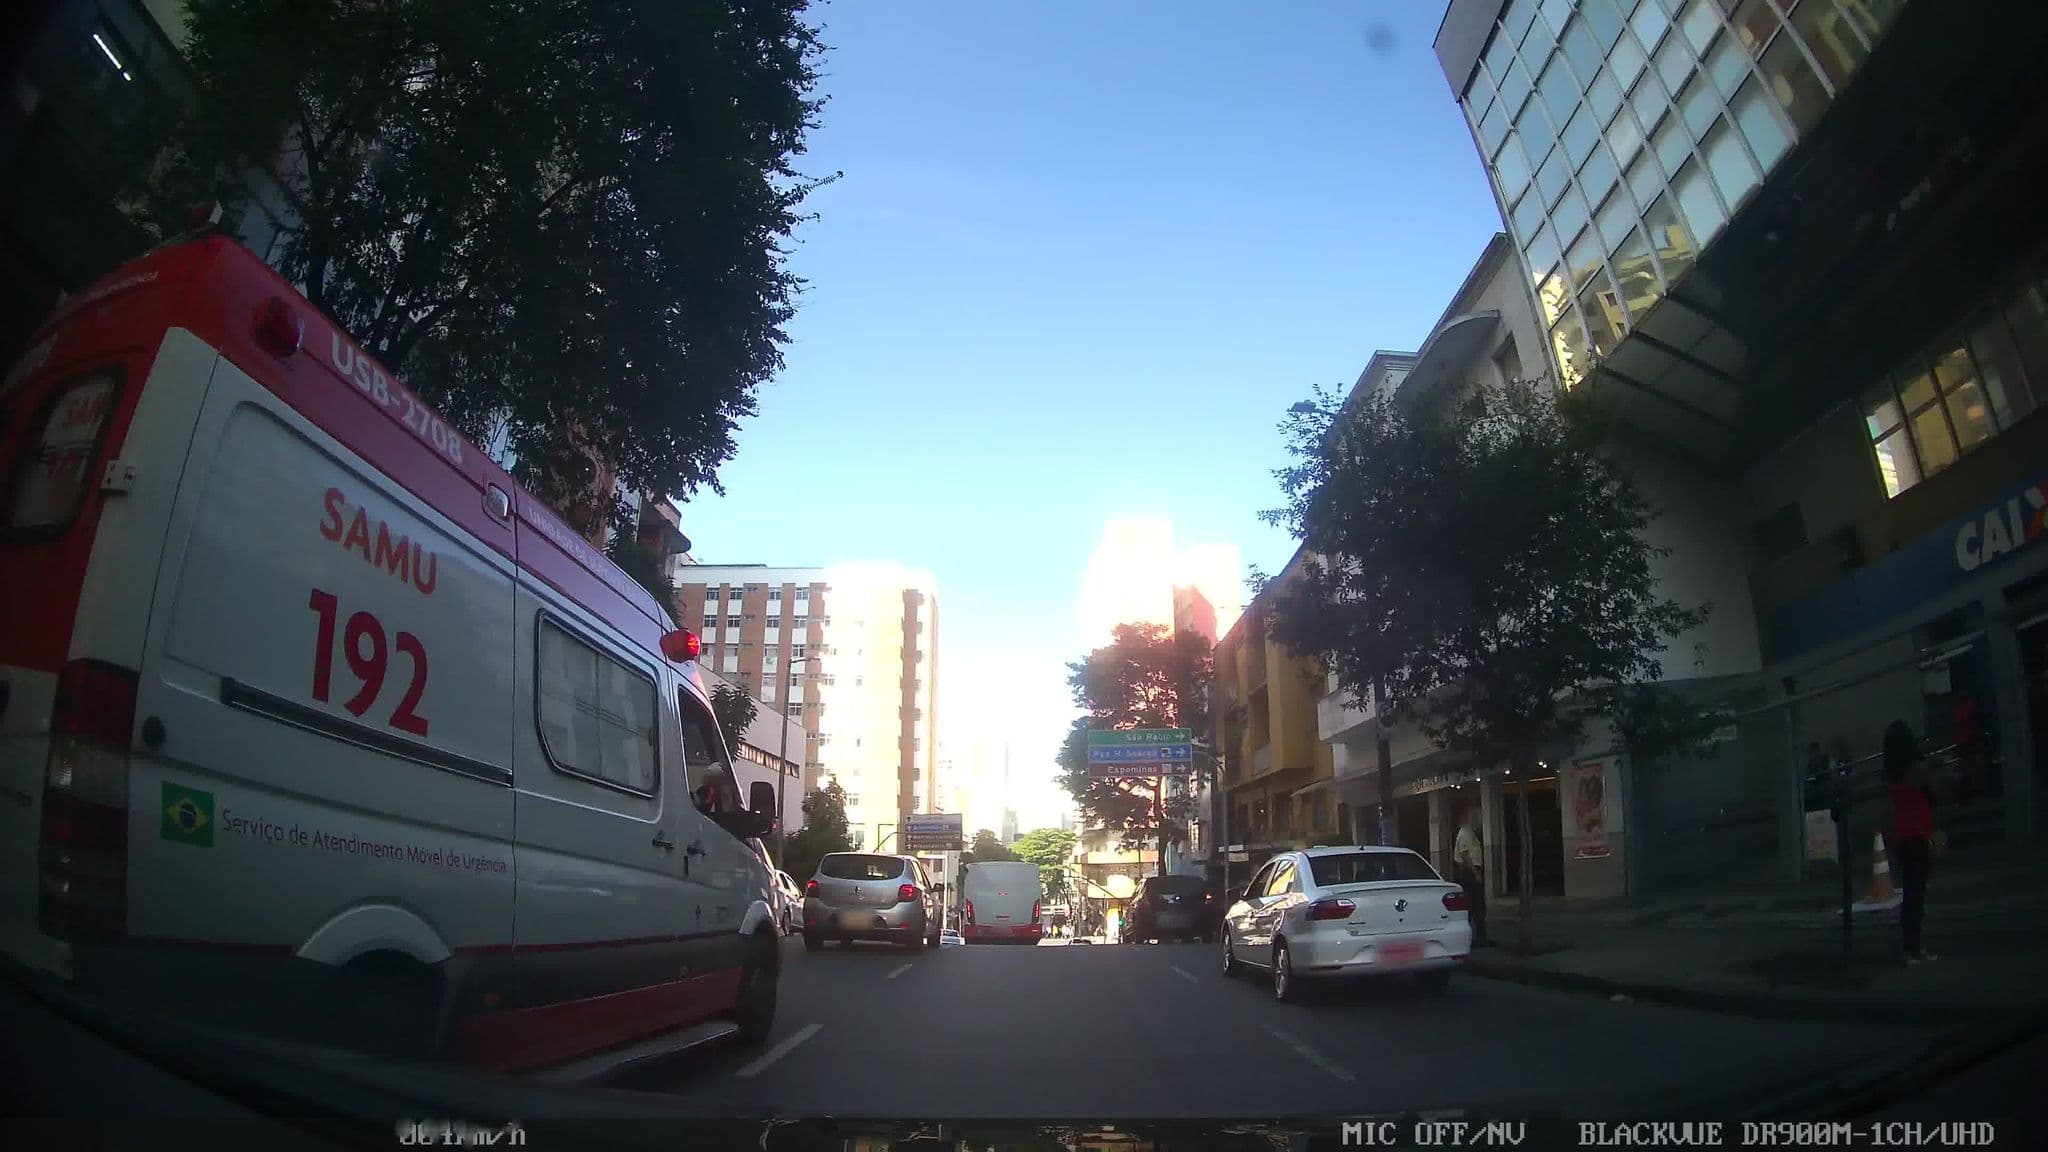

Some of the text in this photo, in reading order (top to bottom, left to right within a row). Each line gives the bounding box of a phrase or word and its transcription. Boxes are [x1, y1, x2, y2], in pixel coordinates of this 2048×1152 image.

[331, 332, 464, 465] USB-2708
[319, 487, 437, 595] SAMU
[309, 588, 429, 737] 192
[1107, 766, 1157, 775] Expominas
[222, 810, 507, 874] Serviço de Atendimento Móvel de Urgência
